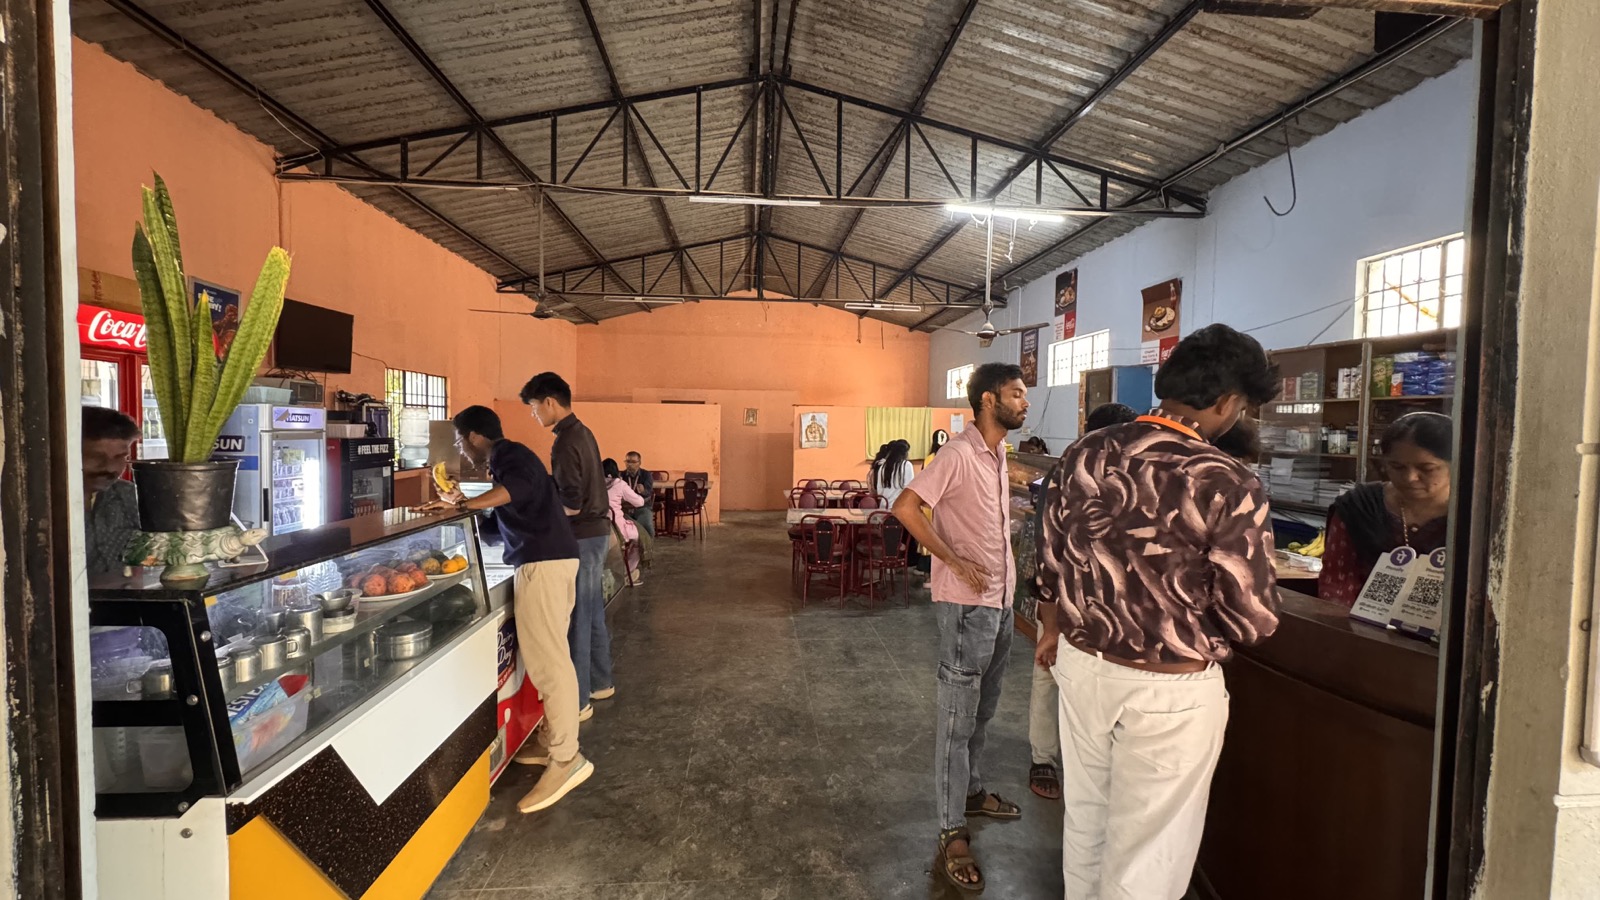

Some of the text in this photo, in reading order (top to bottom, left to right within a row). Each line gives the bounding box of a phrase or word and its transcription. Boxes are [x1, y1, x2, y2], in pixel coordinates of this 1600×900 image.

[88, 310, 147, 348] Coca-C
[358, 445, 371, 455] #FEEL
[371, 444, 380, 454] THE
[497, 646, 513, 667] Day
